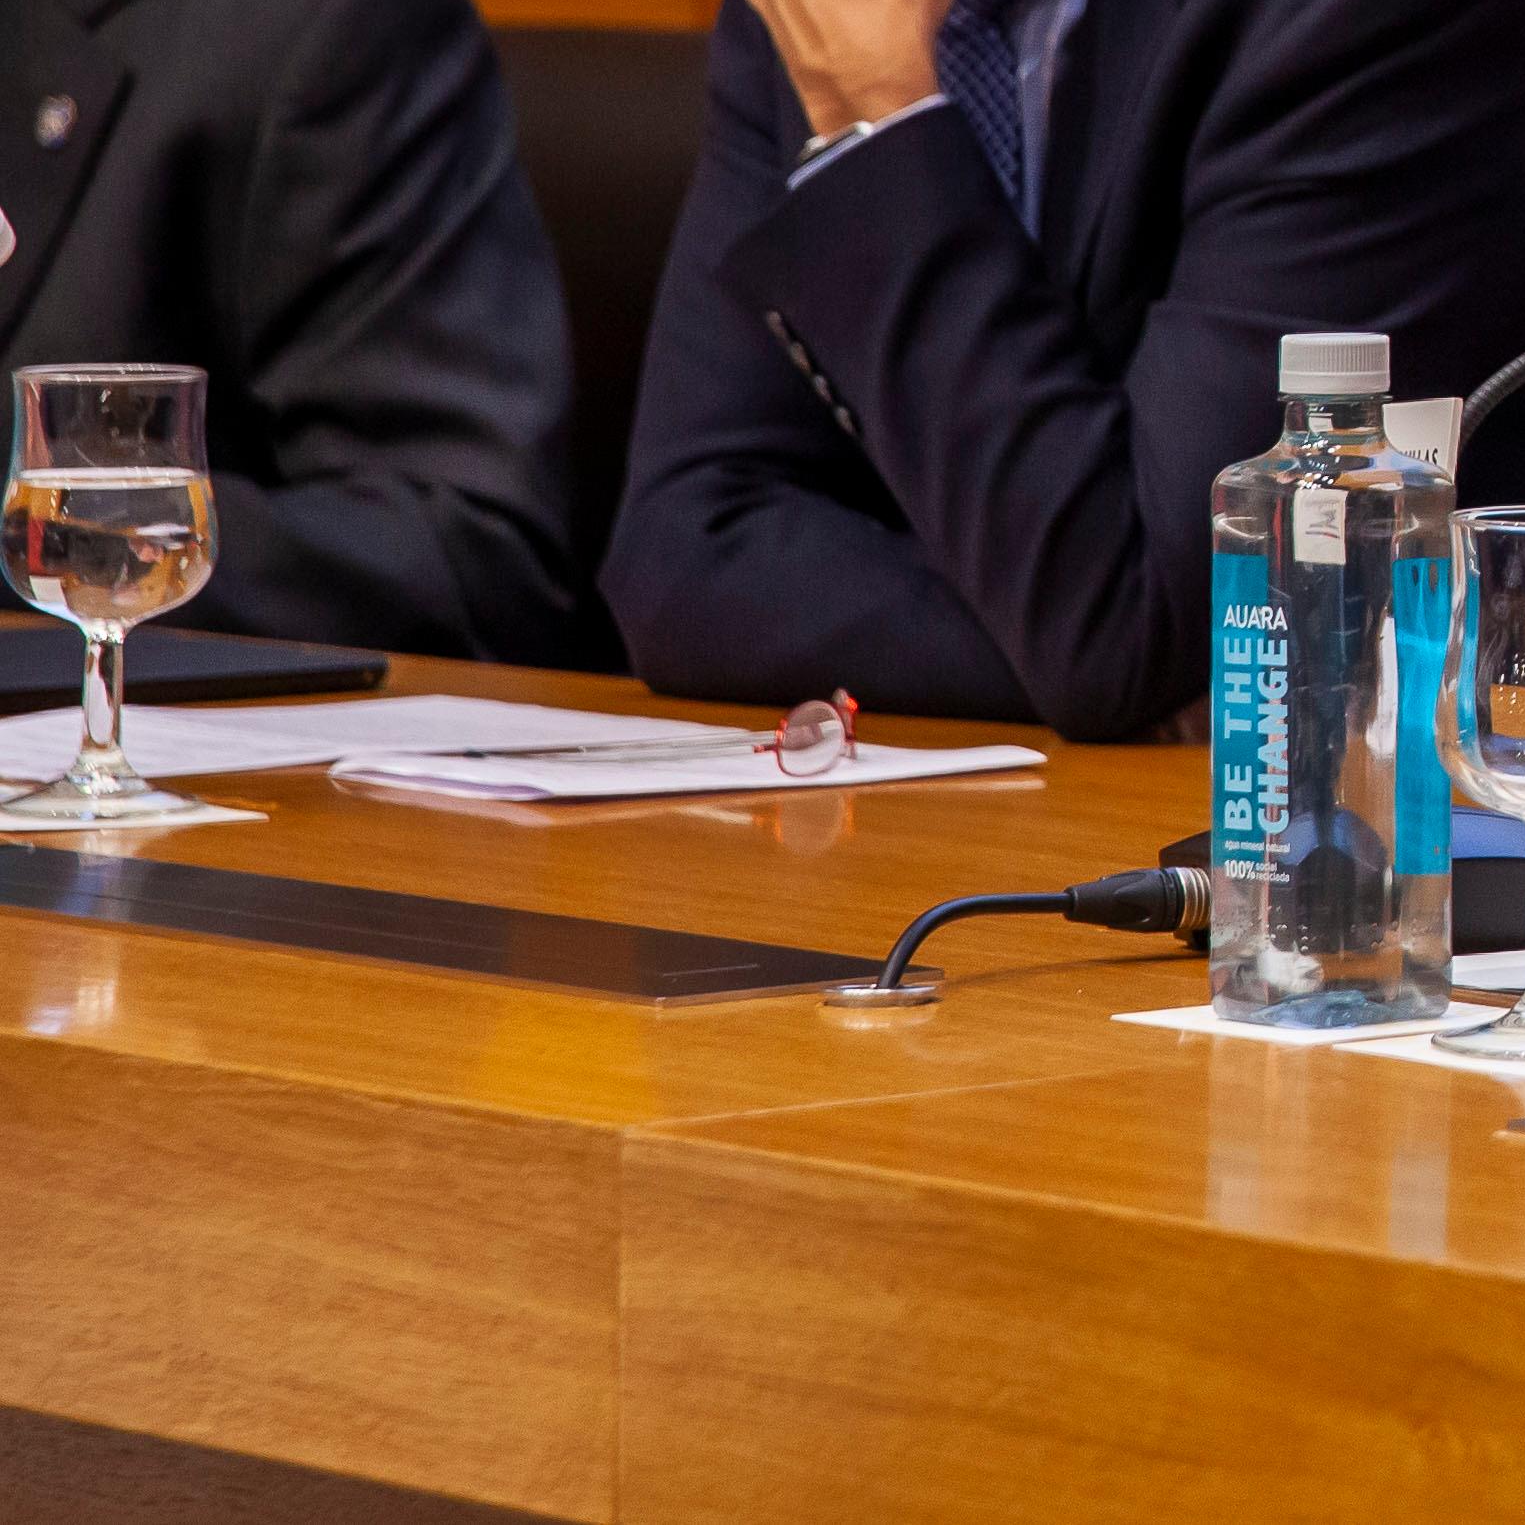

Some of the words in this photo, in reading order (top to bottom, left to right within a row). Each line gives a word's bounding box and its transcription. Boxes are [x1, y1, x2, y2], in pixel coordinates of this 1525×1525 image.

[1223, 604, 1288, 631] AUARA
[1223, 637, 1252, 739] THE
[1257, 638, 1289, 835] CHANGE
[1224, 764, 1253, 830] BE
[1224, 859, 1256, 881] 100%
